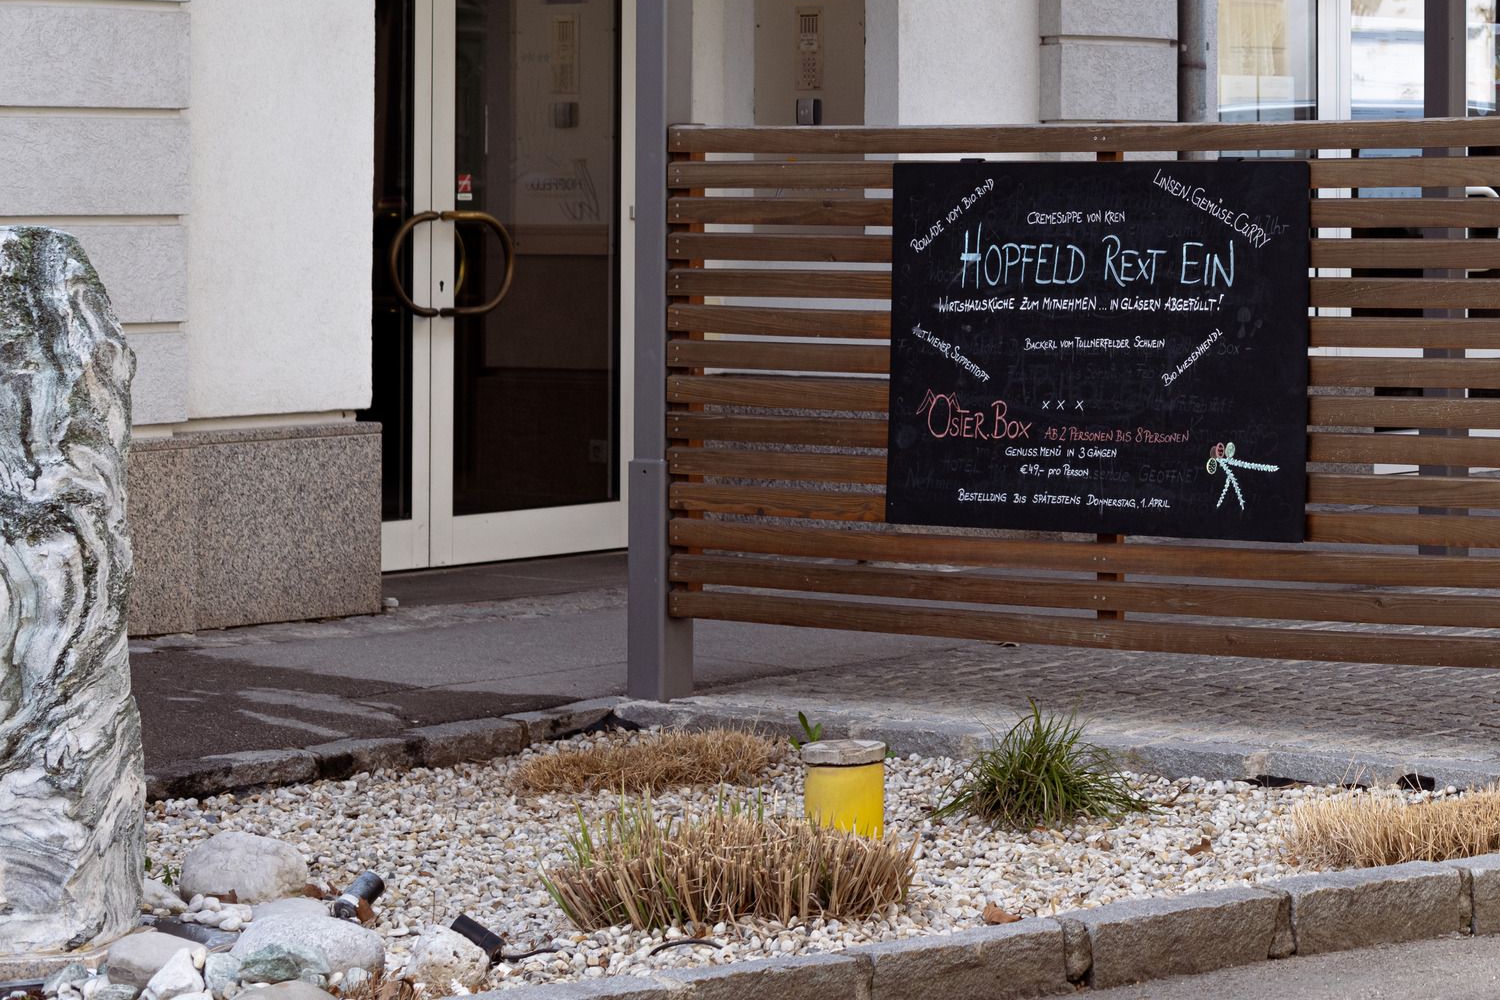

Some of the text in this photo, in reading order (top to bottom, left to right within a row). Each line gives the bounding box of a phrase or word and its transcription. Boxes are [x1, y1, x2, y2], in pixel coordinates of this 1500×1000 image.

[946, 205, 962, 224] VOM
[1027, 210, 1126, 226] CREMESUPPE VON KREN
[960, 221, 1235, 290] HOPFELD REXT EIN
[1019, 296, 1039, 311] ZUM
[1110, 298, 1119, 311] IN
[1120, 296, 1161, 312] GLÄSERN
[1133, 335, 1166, 349] SCHWEIN
[1069, 426, 1114, 442] PERSONEN
[1115, 431, 1132, 442] BIS
[1144, 429, 1190, 443] PERSONEN
[1066, 448, 1075, 457] IN
[1078, 448, 1085, 459] 3
[1062, 463, 1089, 477] PERSON
[958, 488, 1007, 503] BESTELLUNG
[1013, 493, 1027, 504] BIS
[1032, 490, 1081, 505] SPÄTESTENS
[1148, 497, 1171, 509] APRIL
